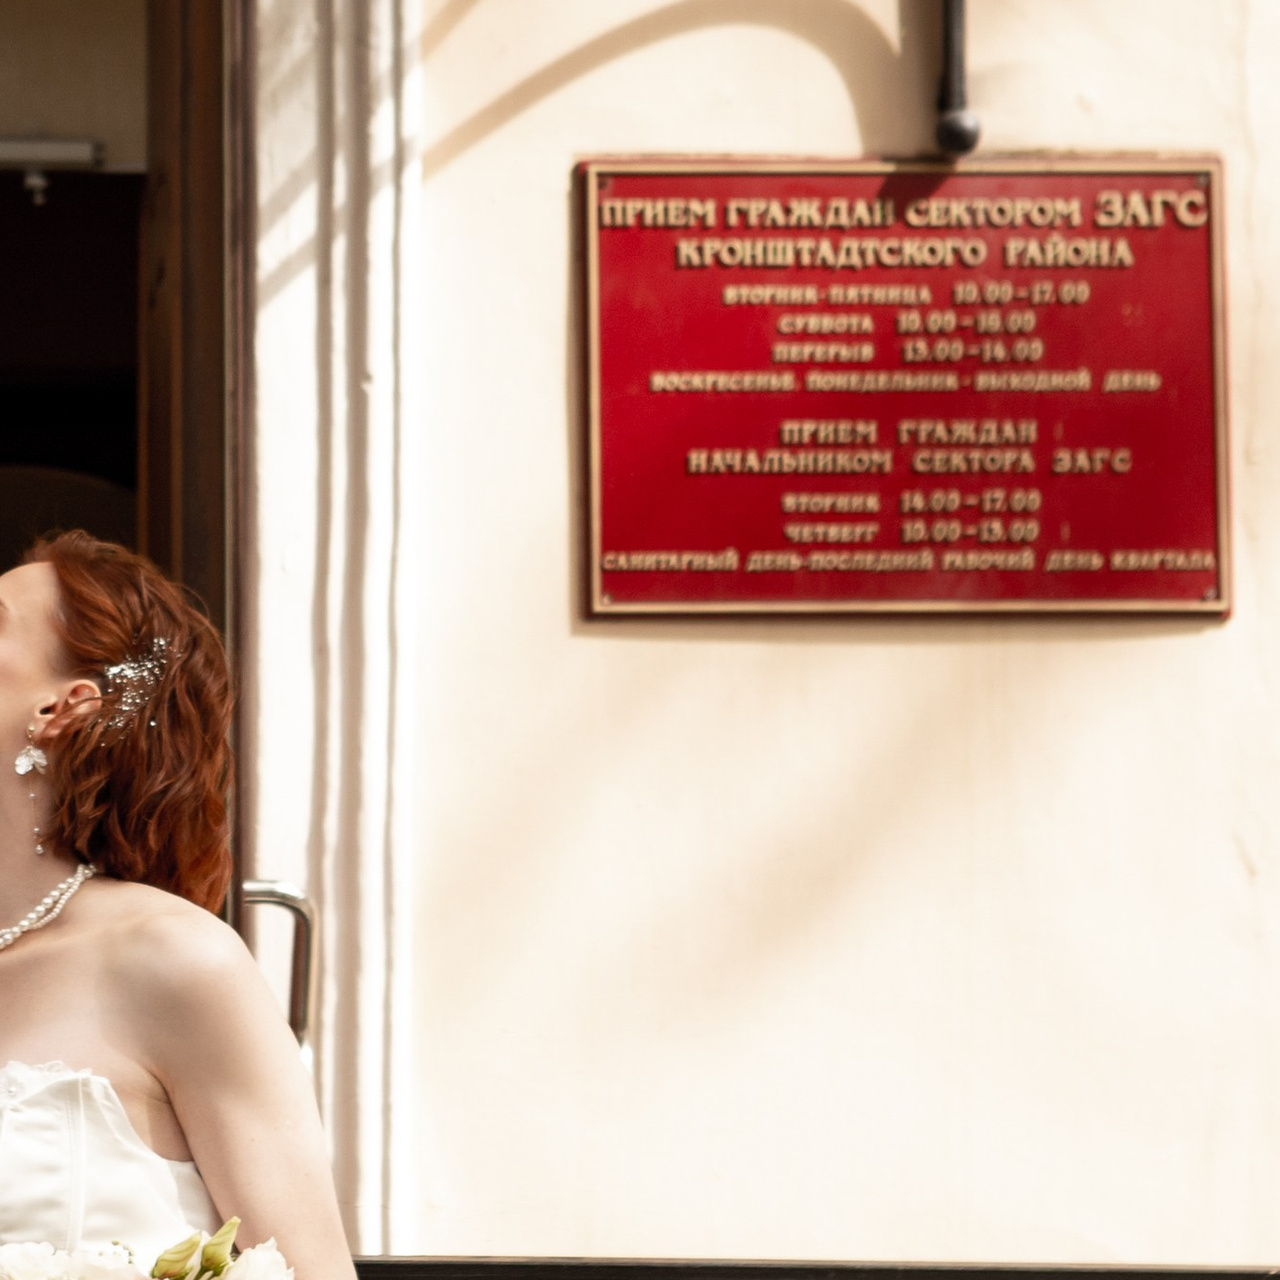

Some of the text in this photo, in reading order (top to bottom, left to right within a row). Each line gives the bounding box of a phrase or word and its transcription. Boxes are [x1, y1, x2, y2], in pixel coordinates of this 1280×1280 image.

[600, 190, 1208, 229] ПРИЕМ ГРАЖДАН СЕКТОРОМ ЗАГС
[676, 232, 1134, 269] КРОНШТАДТСКОГО РАЙОНА
[778, 313, 874, 335] СУББОТА
[773, 342, 874, 363] ПЕРЕРЫВ
[781, 419, 1038, 445] ПРИЕМ ГРАЖДАН
[687, 448, 1132, 474] НАЧАЛЬНИКОМ СЕКТОРА ЗАГС
[781, 492, 880, 513] ВТОРНИК
[784, 522, 880, 543] ЧЕТВЕРГ
